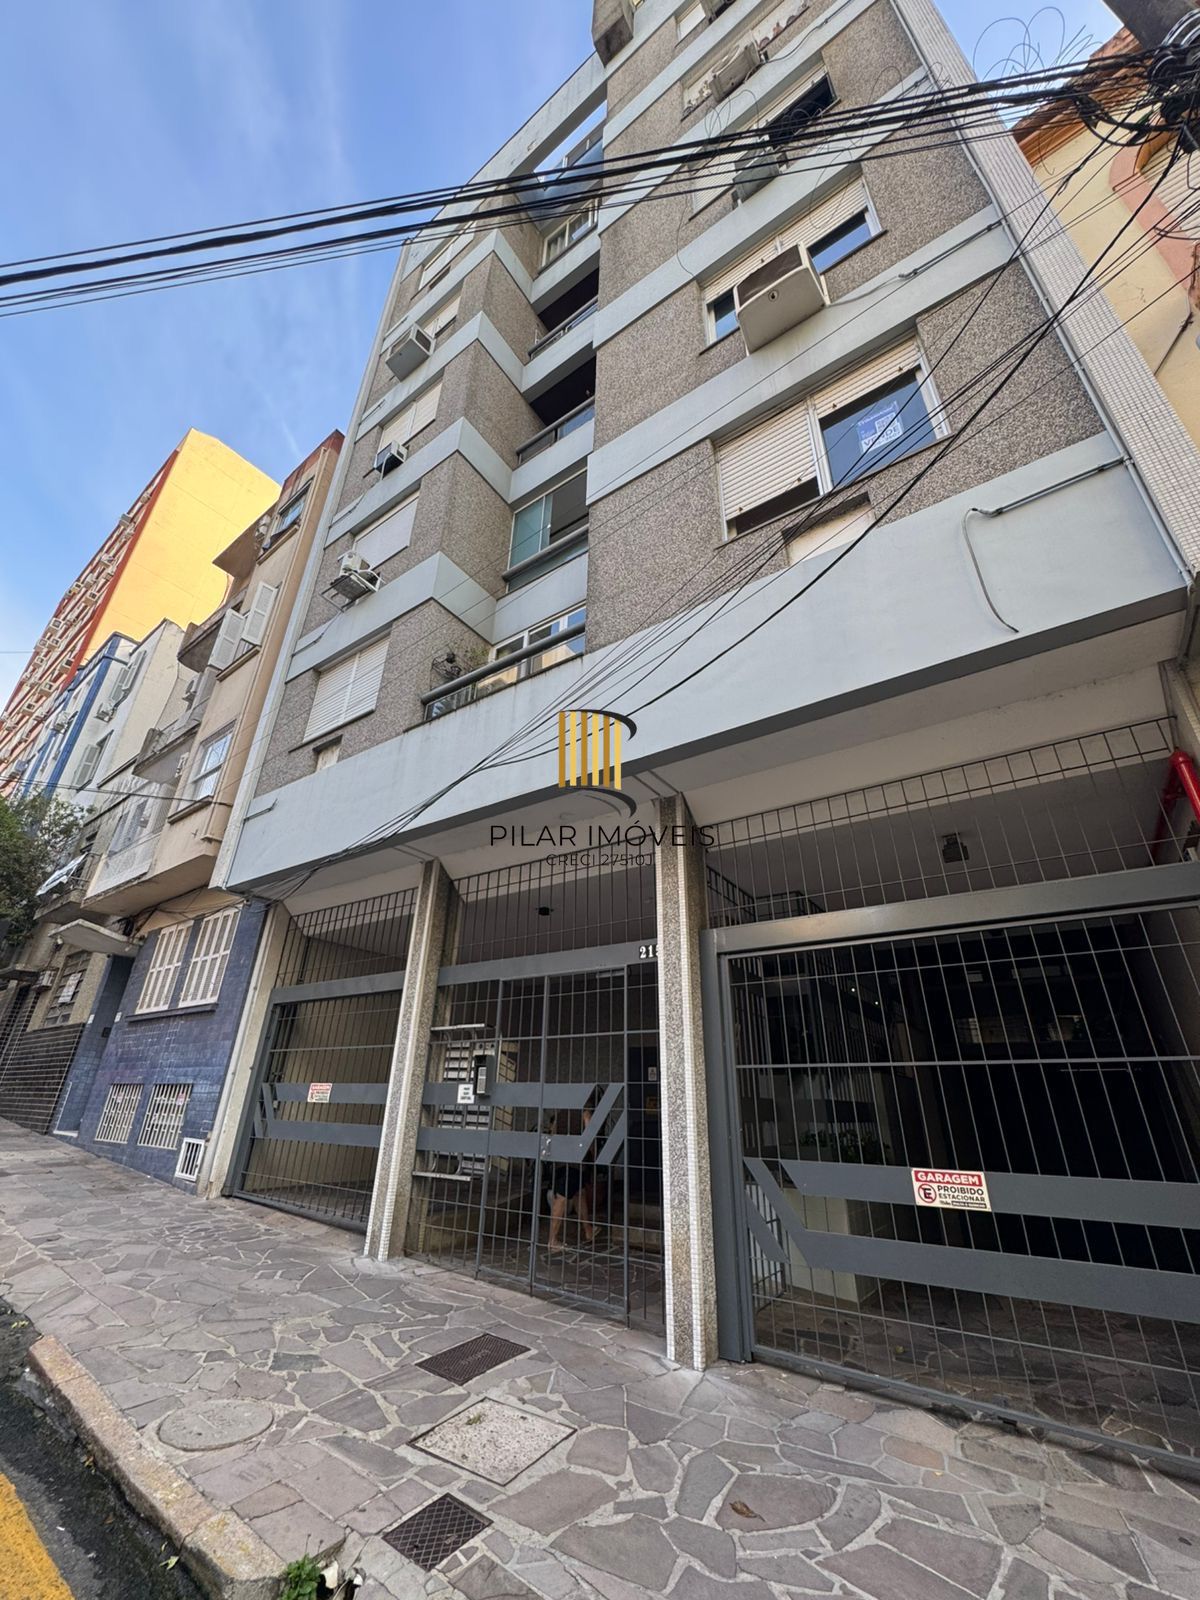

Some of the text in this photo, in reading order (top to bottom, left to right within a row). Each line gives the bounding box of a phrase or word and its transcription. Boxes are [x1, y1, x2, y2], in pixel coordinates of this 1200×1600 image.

[917, 1172, 980, 1185] GARAGEM
[937, 1185, 984, 1196] PROIBIDO
[939, 1193, 986, 1202] ESTACIONAR
